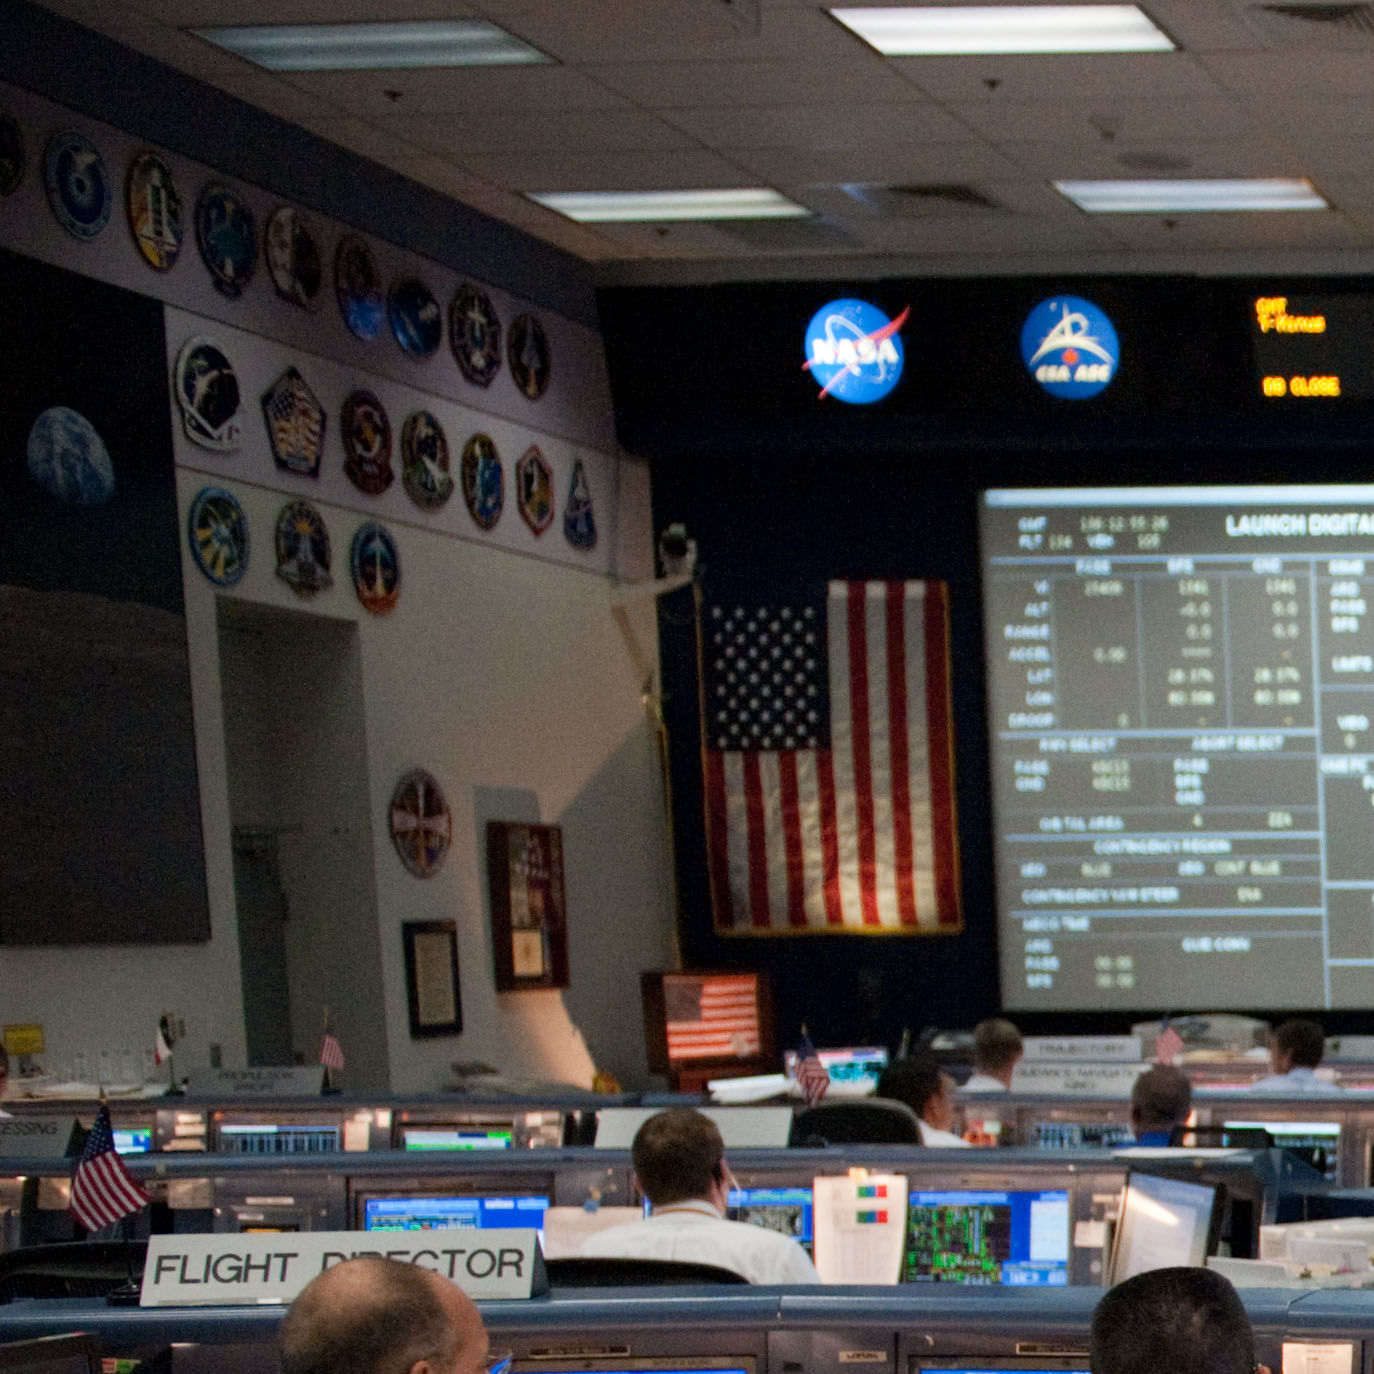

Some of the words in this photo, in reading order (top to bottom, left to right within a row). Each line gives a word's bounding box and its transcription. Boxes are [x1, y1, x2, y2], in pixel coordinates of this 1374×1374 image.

[812, 338, 899, 366] NASA
[1225, 514, 1306, 536] LAUNCH
[153, 1252, 298, 1286] FLIGHT
[321, 1248, 525, 1281] DCTOR
